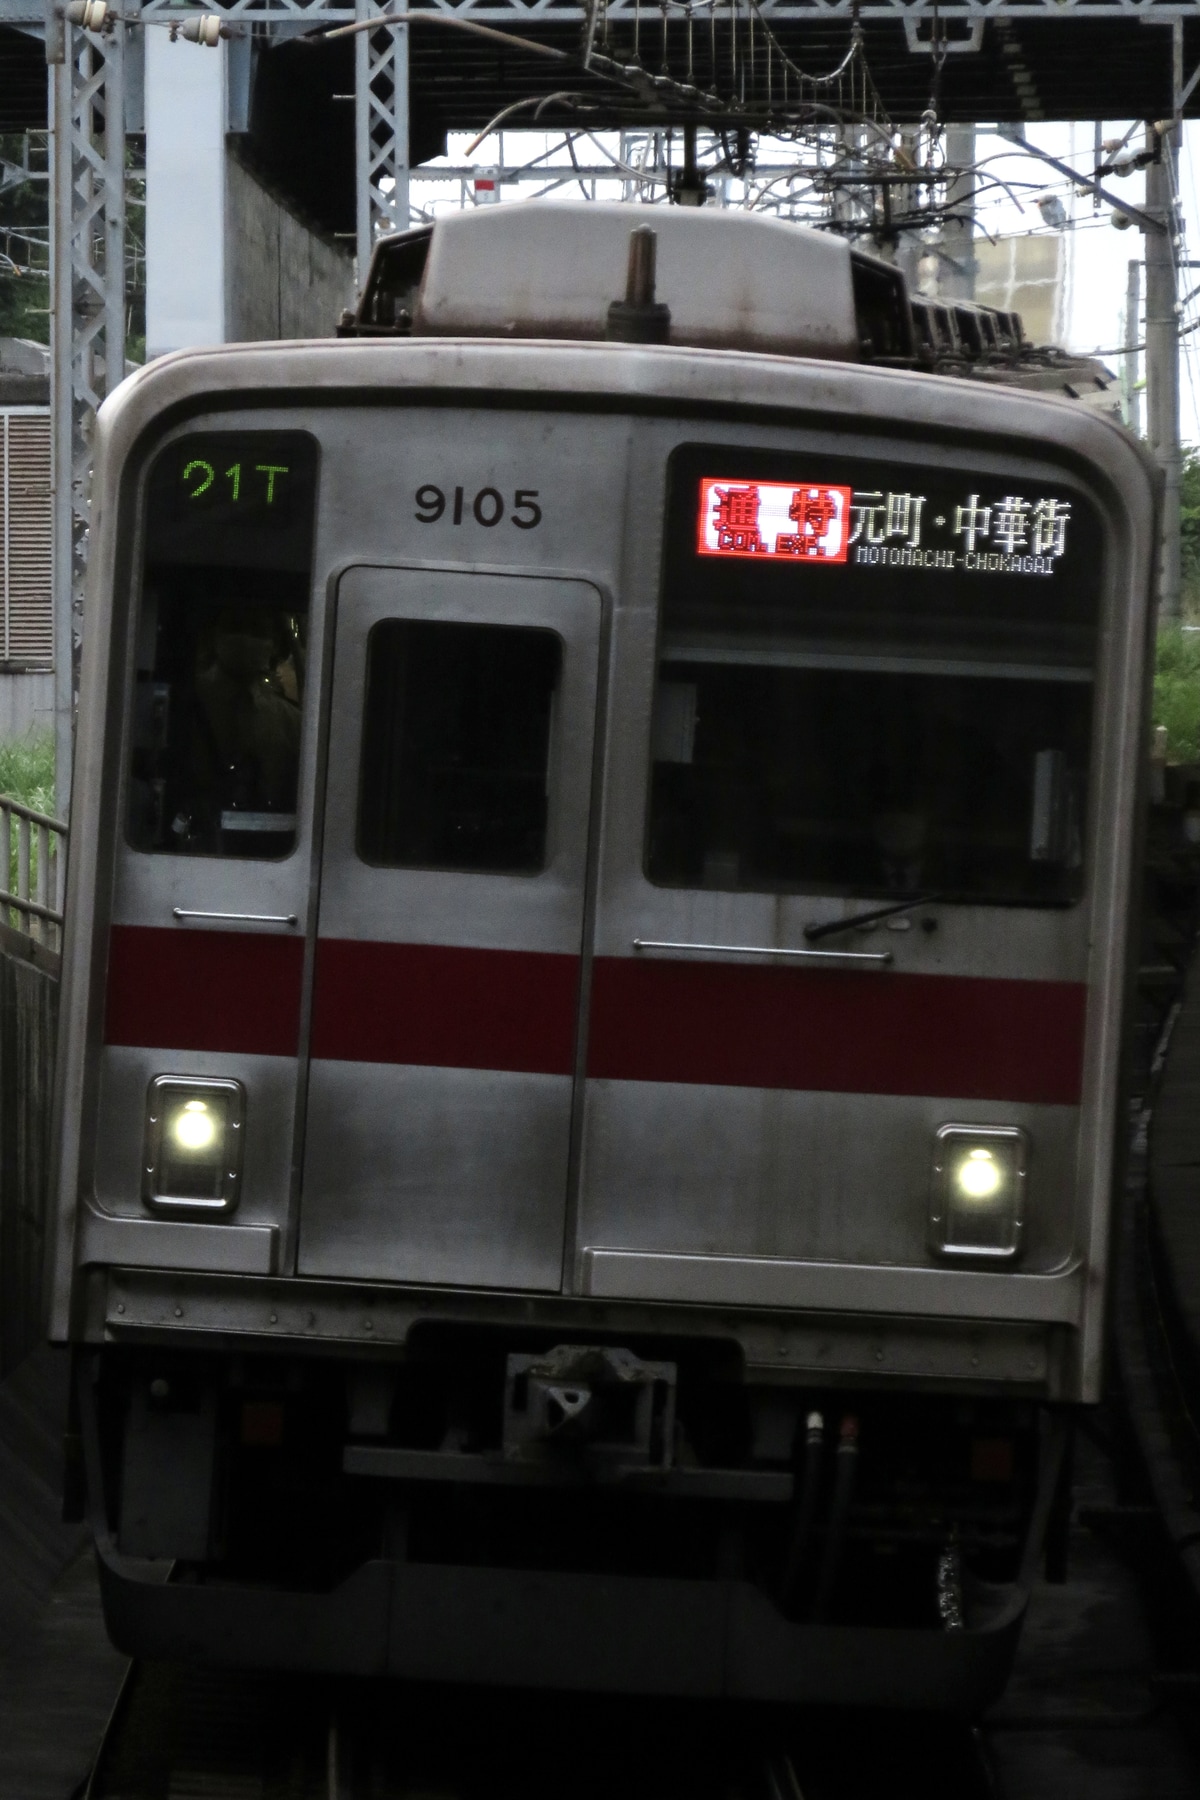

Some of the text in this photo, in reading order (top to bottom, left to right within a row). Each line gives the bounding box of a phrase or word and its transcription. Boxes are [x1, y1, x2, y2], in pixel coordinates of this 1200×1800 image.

[183, 460, 289, 504] 21T
[414, 484, 543, 530] 9105
[847, 491, 1072, 556] 元町・中華街
